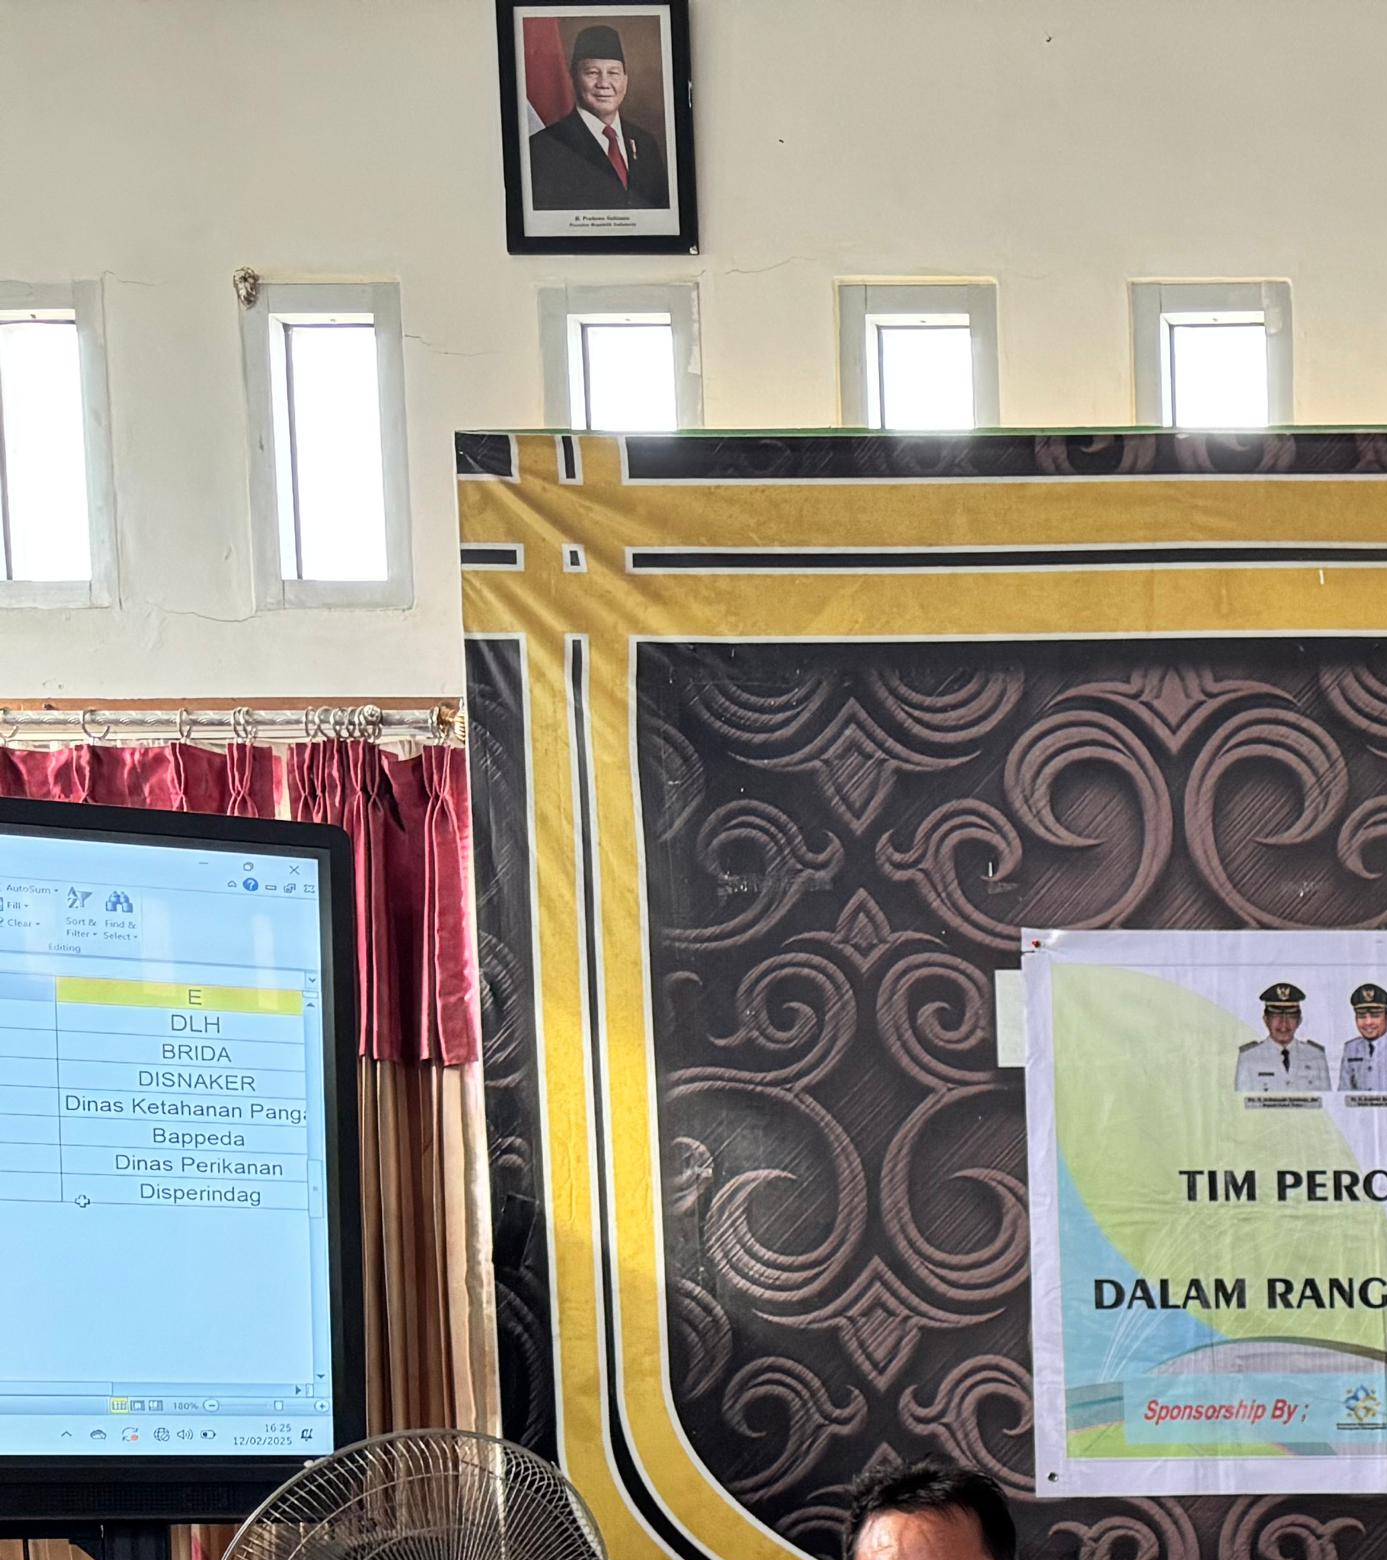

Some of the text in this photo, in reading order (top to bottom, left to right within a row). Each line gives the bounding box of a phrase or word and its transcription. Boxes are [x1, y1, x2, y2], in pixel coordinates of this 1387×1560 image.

[6, 884, 51, 895] AutoSum
[7, 918, 32, 928] Clear
[66, 917, 85, 926] Sort
[105, 919, 125, 928] Find
[66, 929, 89, 938] Filter
[103, 931, 131, 940] Select
[188, 989, 202, 1006] E
[171, 1014, 221, 1034] DLH
[162, 1044, 232, 1063] BRIDA
[139, 1071, 256, 1092] DISNAKER
[65, 1095, 124, 1113] Dinas
[132, 1098, 242, 1119] Ketahanan
[153, 1128, 245, 1148] Bappeda
[115, 1155, 283, 1176] Dinas Perikanan
[140, 1184, 261, 1206] Disperindag
[1179, 1171, 1256, 1201] TIM
[1094, 1279, 1246, 1309] DALAM
[1144, 1399, 1267, 1425] Sponsorship
[1271, 1398, 1298, 1425] By
[233, 1436, 293, 1447] 12/02/2025
